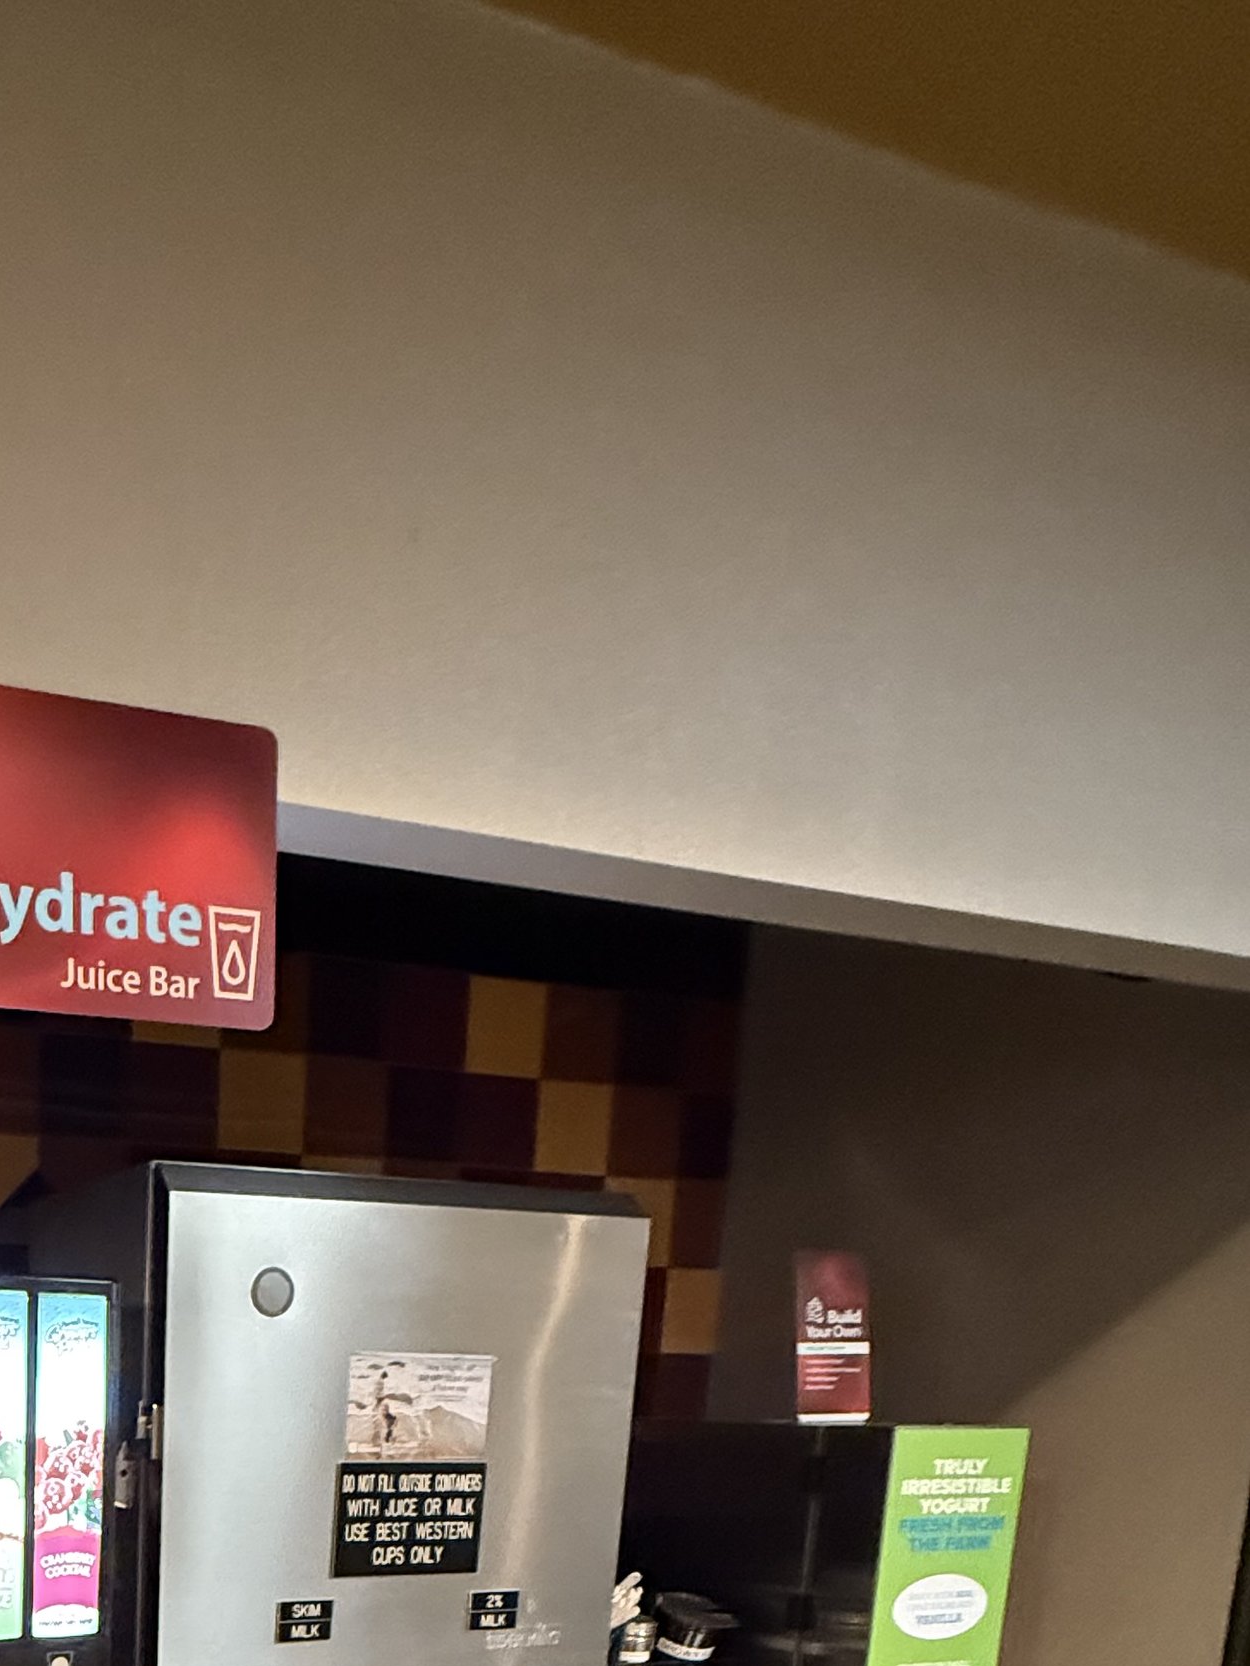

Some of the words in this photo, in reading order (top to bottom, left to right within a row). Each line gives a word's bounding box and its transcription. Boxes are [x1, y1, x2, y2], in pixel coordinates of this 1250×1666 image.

[60, 957, 141, 994] Juice
[149, 965, 200, 1000] Bar
[827, 1308, 862, 1324] Build
[806, 1325, 832, 1338] Your
[833, 1324, 862, 1338] Own
[933, 1457, 989, 1475] TRULY
[342, 1474, 356, 1493] DO
[357, 1474, 376, 1492] NOT
[378, 1474, 396, 1493] FILL
[398, 1473, 432, 1492] OUTSIDE
[434, 1473, 482, 1492] CONTAINERS
[900, 1477, 1013, 1496] IRRESISTIBLE
[347, 1498, 380, 1517] WITH
[385, 1497, 418, 1517] JUICE
[424, 1497, 442, 1516] OR
[447, 1497, 476, 1516] MILK
[919, 1497, 991, 1514] YOGURT
[344, 1521, 370, 1542] USE
[375, 1521, 409, 1541] BEST
[415, 1520, 474, 1540] WESTERN
[372, 1545, 405, 1566] CUPS
[410, 1544, 444, 1565] ONLY
[291, 1602, 321, 1618] SKIM
[485, 1594, 504, 1609] 2%
[479, 1613, 507, 1628] MILK
[290, 1623, 321, 1638] MILK
